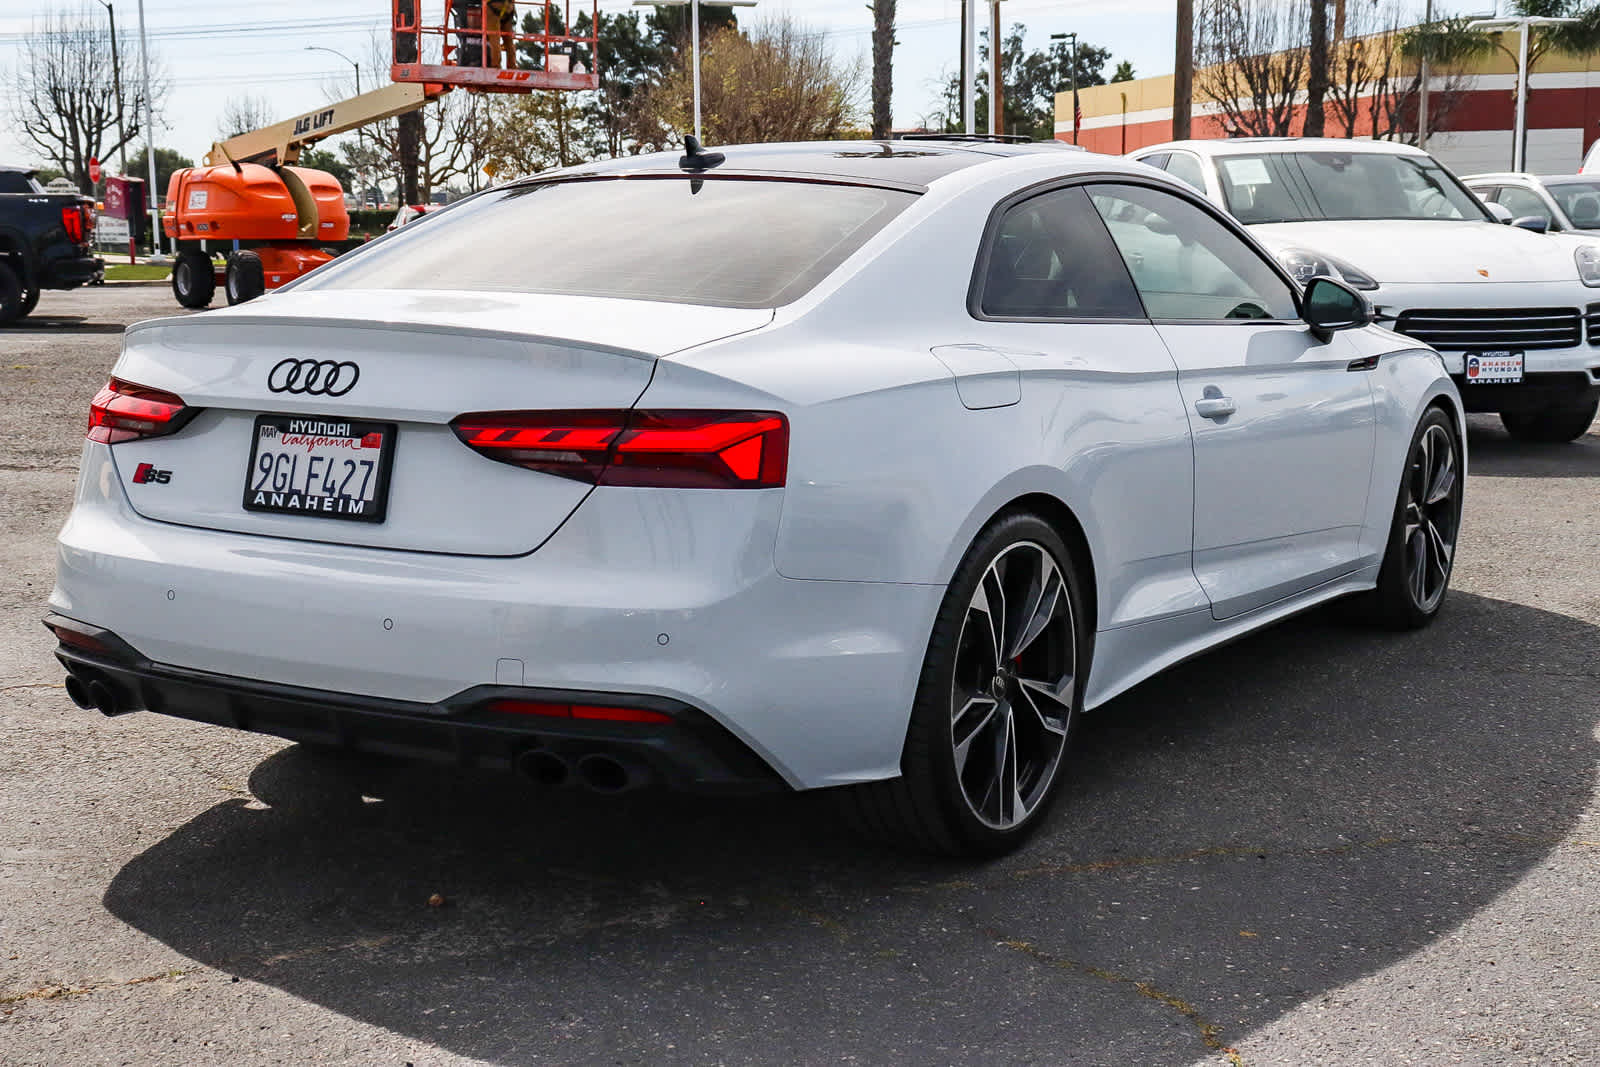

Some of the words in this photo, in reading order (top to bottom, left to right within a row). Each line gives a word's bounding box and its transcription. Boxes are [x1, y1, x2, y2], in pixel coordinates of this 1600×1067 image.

[293, 116, 310, 136] JLG
[313, 109, 335, 129] LIFT
[261, 426, 278, 439] MAY
[289, 420, 351, 437] HYUNDAI
[281, 432, 361, 453] California
[254, 452, 376, 501] 9GLF427
[253, 491, 365, 514] ANAHEIM
